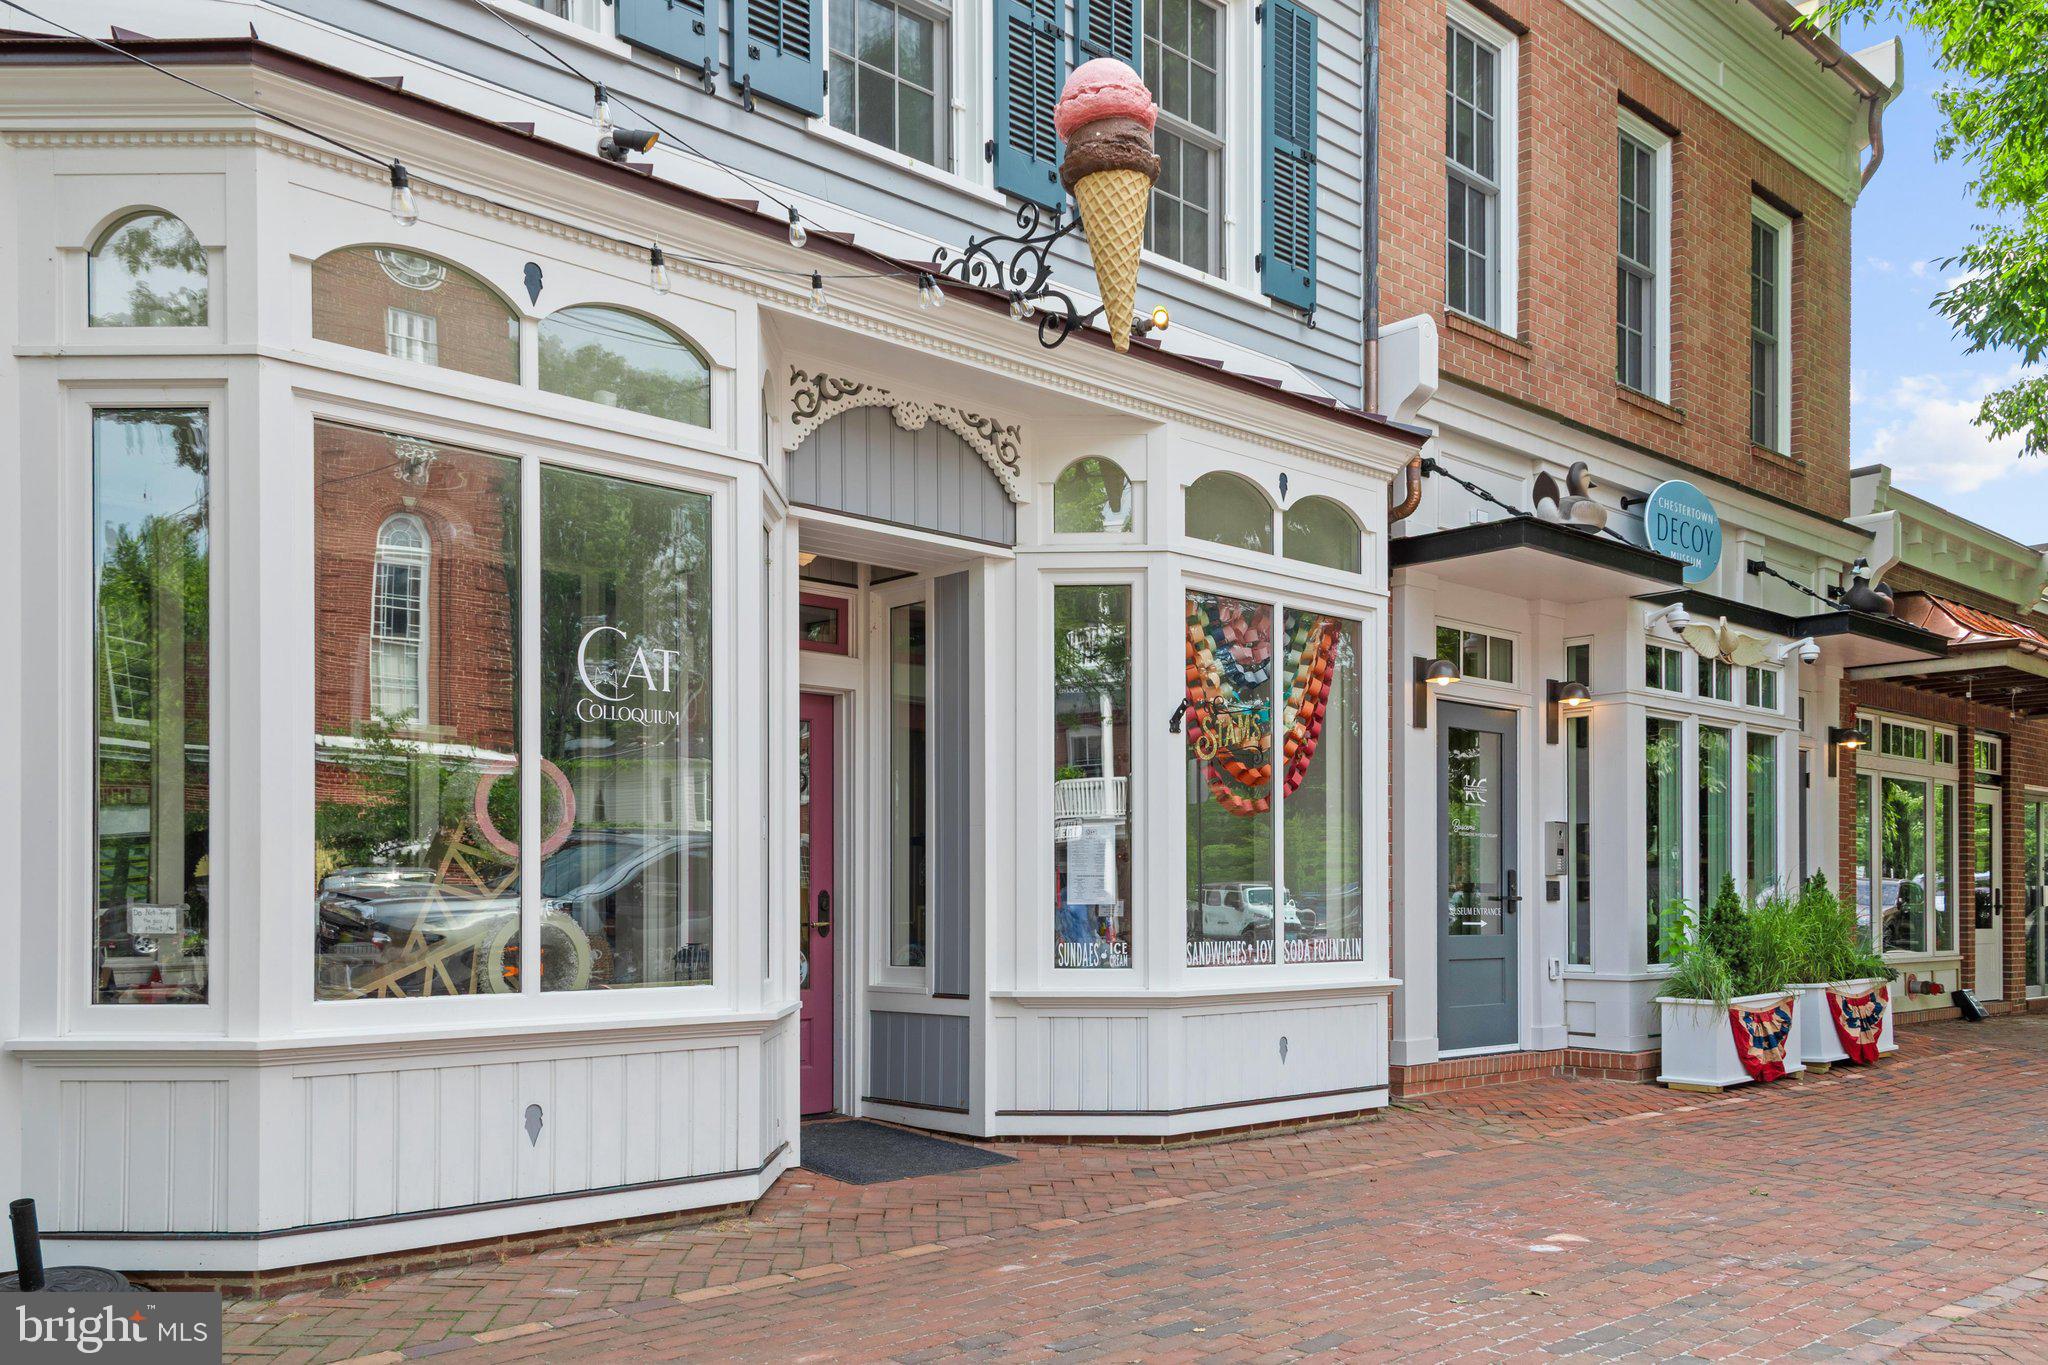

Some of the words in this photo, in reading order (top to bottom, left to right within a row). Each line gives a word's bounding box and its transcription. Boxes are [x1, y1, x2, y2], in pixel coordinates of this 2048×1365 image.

[1658, 497, 1714, 525] CHESTERTOWN
[1657, 513, 1714, 556] DECOY
[1670, 550, 1702, 568] MUSEUM
[577, 626, 680, 702] CAT
[576, 697, 680, 727] COLLOQUIUM
[1473, 907, 1502, 917] ENTRANCE
[1058, 943, 1099, 967] SUNDAES
[1109, 942, 1128, 955] ICE
[1109, 954, 1128, 967] CREAM
[1186, 941, 1247, 966] SANDWICHES
[1254, 940, 1274, 963] JOY
[1284, 939, 1310, 962] SODA
[1313, 938, 1362, 961] FOUNTAIN
